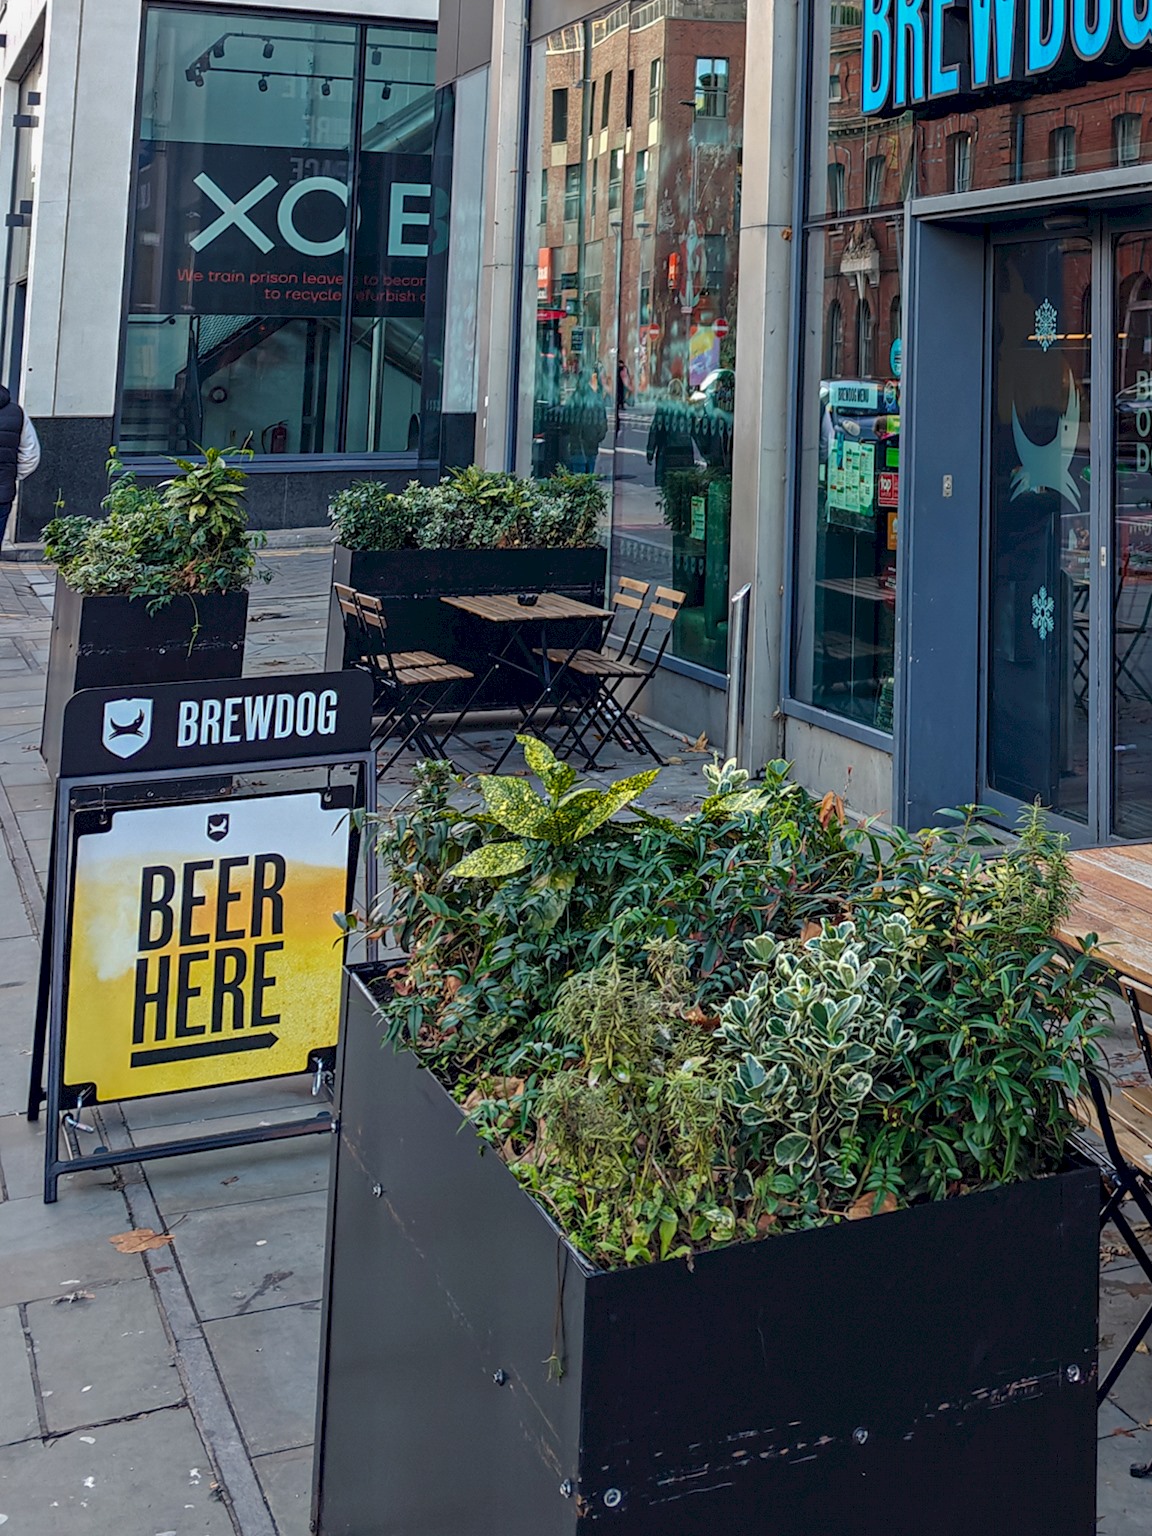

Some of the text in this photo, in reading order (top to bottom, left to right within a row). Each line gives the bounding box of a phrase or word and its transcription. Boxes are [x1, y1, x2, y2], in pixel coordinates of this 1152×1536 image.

[177, 268, 204, 283] We
[208, 268, 245, 284] train
[249, 270, 299, 286] prison
[264, 288, 281, 301] to
[177, 689, 339, 748] BREWDOG
[138, 853, 287, 952] BEER
[132, 940, 284, 1045] HERE
